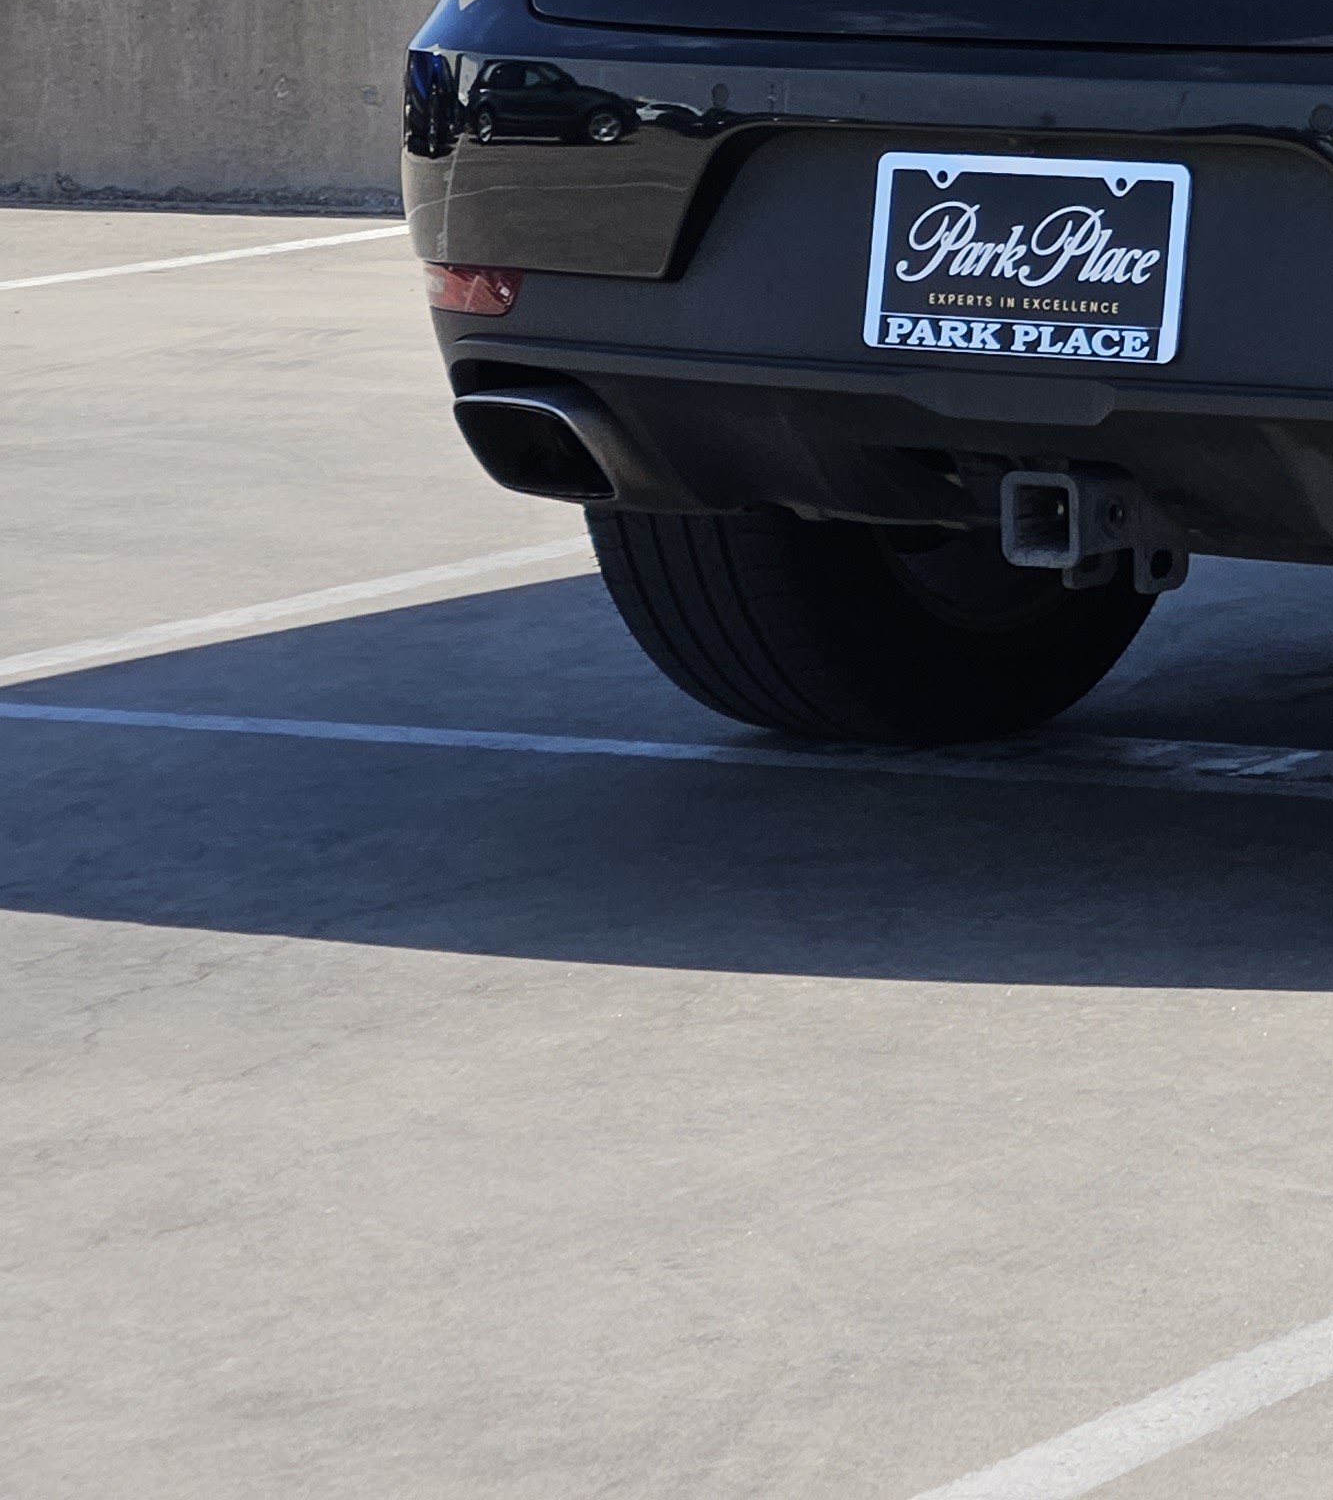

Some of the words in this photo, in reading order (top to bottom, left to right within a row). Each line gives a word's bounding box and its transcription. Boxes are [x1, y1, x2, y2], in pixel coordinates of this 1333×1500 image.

[895, 200, 1027, 283] Park
[1017, 205, 1161, 287] Place
[928, 292, 993, 308] EXPERTS
[1000, 296, 1016, 309] IN
[1022, 297, 1121, 315] EXCELLENCE
[884, 316, 1003, 350] PARK
[1010, 324, 1150, 359] PLACE
